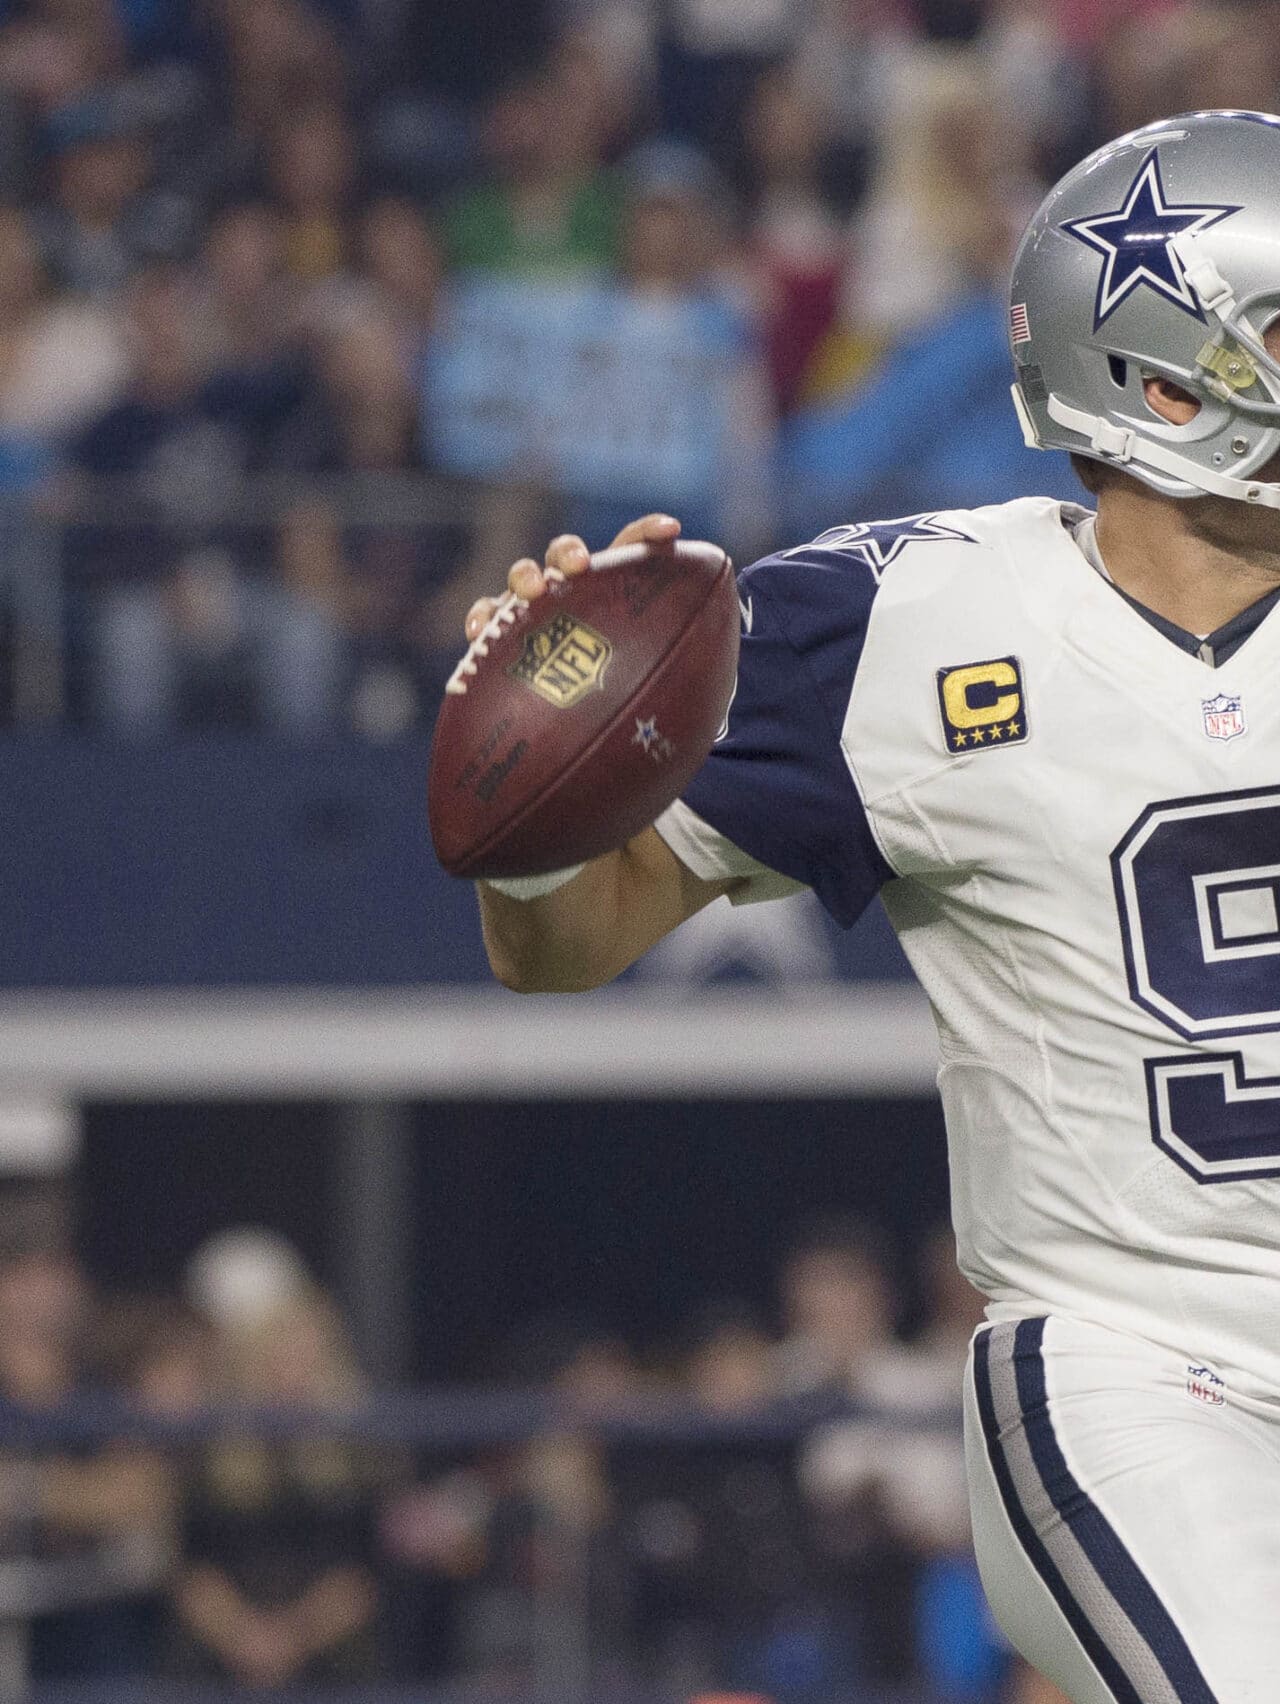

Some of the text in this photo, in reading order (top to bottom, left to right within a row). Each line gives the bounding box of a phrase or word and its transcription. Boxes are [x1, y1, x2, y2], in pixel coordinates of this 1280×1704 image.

[542, 637, 602, 695] NFL
[943, 662, 1020, 729] C
[1208, 713, 1241, 736] NFL
[1191, 1382, 1220, 1402] NFL
